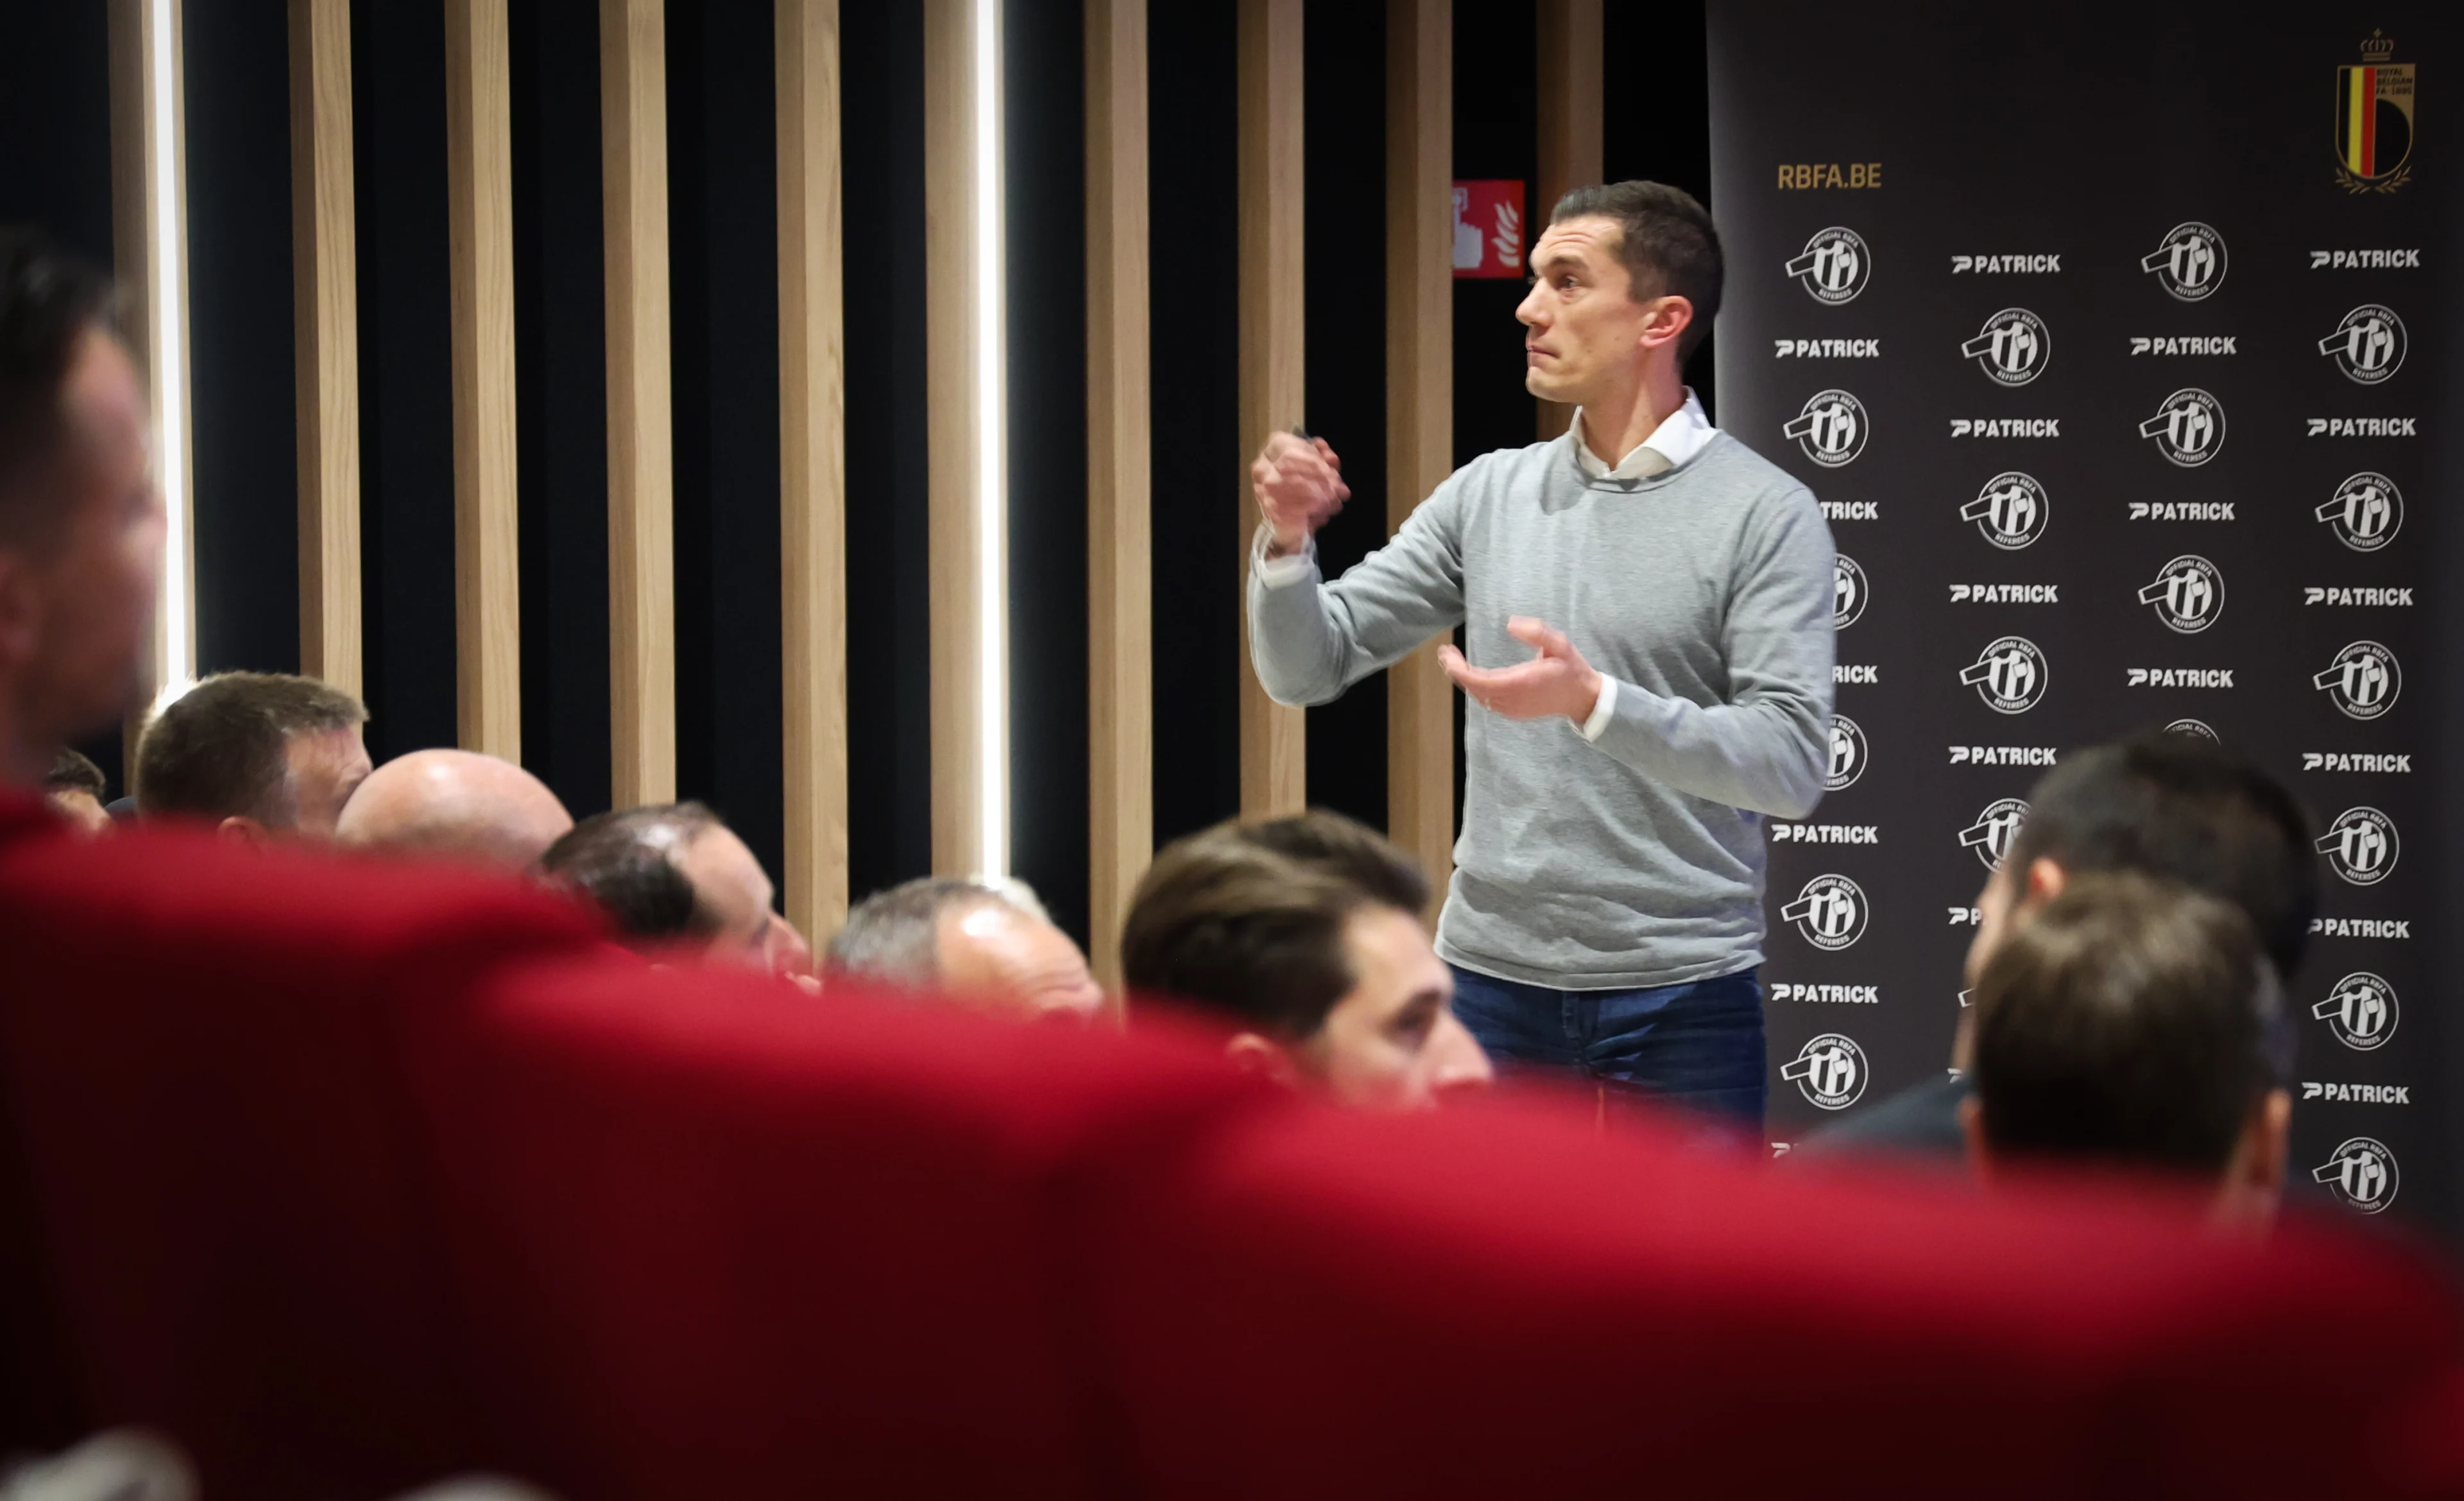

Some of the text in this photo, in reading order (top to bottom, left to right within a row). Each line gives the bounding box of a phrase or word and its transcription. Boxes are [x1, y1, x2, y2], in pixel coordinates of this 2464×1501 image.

[1778, 163, 1882, 189] RBFA.BE
[1812, 231, 1839, 248] OFFICIAL
[2169, 227, 2196, 243] OFFICIAL
[1974, 254, 2061, 273] PATRICK
[2332, 249, 2420, 269] PATRICK
[1991, 313, 2019, 329] OFFICIAL
[2347, 309, 2375, 326] OFFICIAL
[1796, 338, 1879, 358] PATRICK
[2153, 336, 2237, 356] PATRICK
[1811, 394, 1837, 411] OFFICIAL
[2168, 393, 2194, 409] OFFICIAL
[1973, 418, 2060, 438] PATRICK
[2329, 417, 2417, 436] PATRICK
[1990, 476, 2017, 493] OFFICIAL
[2344, 476, 2372, 493] OFFICIAL
[1820, 501, 1879, 520] TRICK
[2151, 502, 2236, 521] PATRICK
[2168, 560, 2193, 576] OFFICIAL
[1972, 584, 2058, 603] PATRICK
[2327, 587, 2413, 606] PATRICK
[1989, 640, 2016, 657] OFFICIAL
[2341, 645, 2369, 662] OFFICIAL
[1831, 664, 1879, 684] RICK
[2150, 668, 2234, 689] PATRICK
[1971, 746, 2057, 766] PATRICK
[2325, 753, 2411, 773] PATRICK
[2340, 811, 2368, 828] OFFICIAL
[1793, 825, 1879, 845] PATRICK
[1809, 879, 1838, 895] OFFICIAL
[2323, 918, 2410, 939] PATRICK
[1792, 984, 1879, 1004] PATRICK
[2340, 976, 2368, 993] OFFICIAL
[1809, 1038, 1838, 1054] OFFICIAL
[2325, 1083, 2409, 1104] PATRICK
[2340, 1142, 2368, 1158] OFFICIAL
